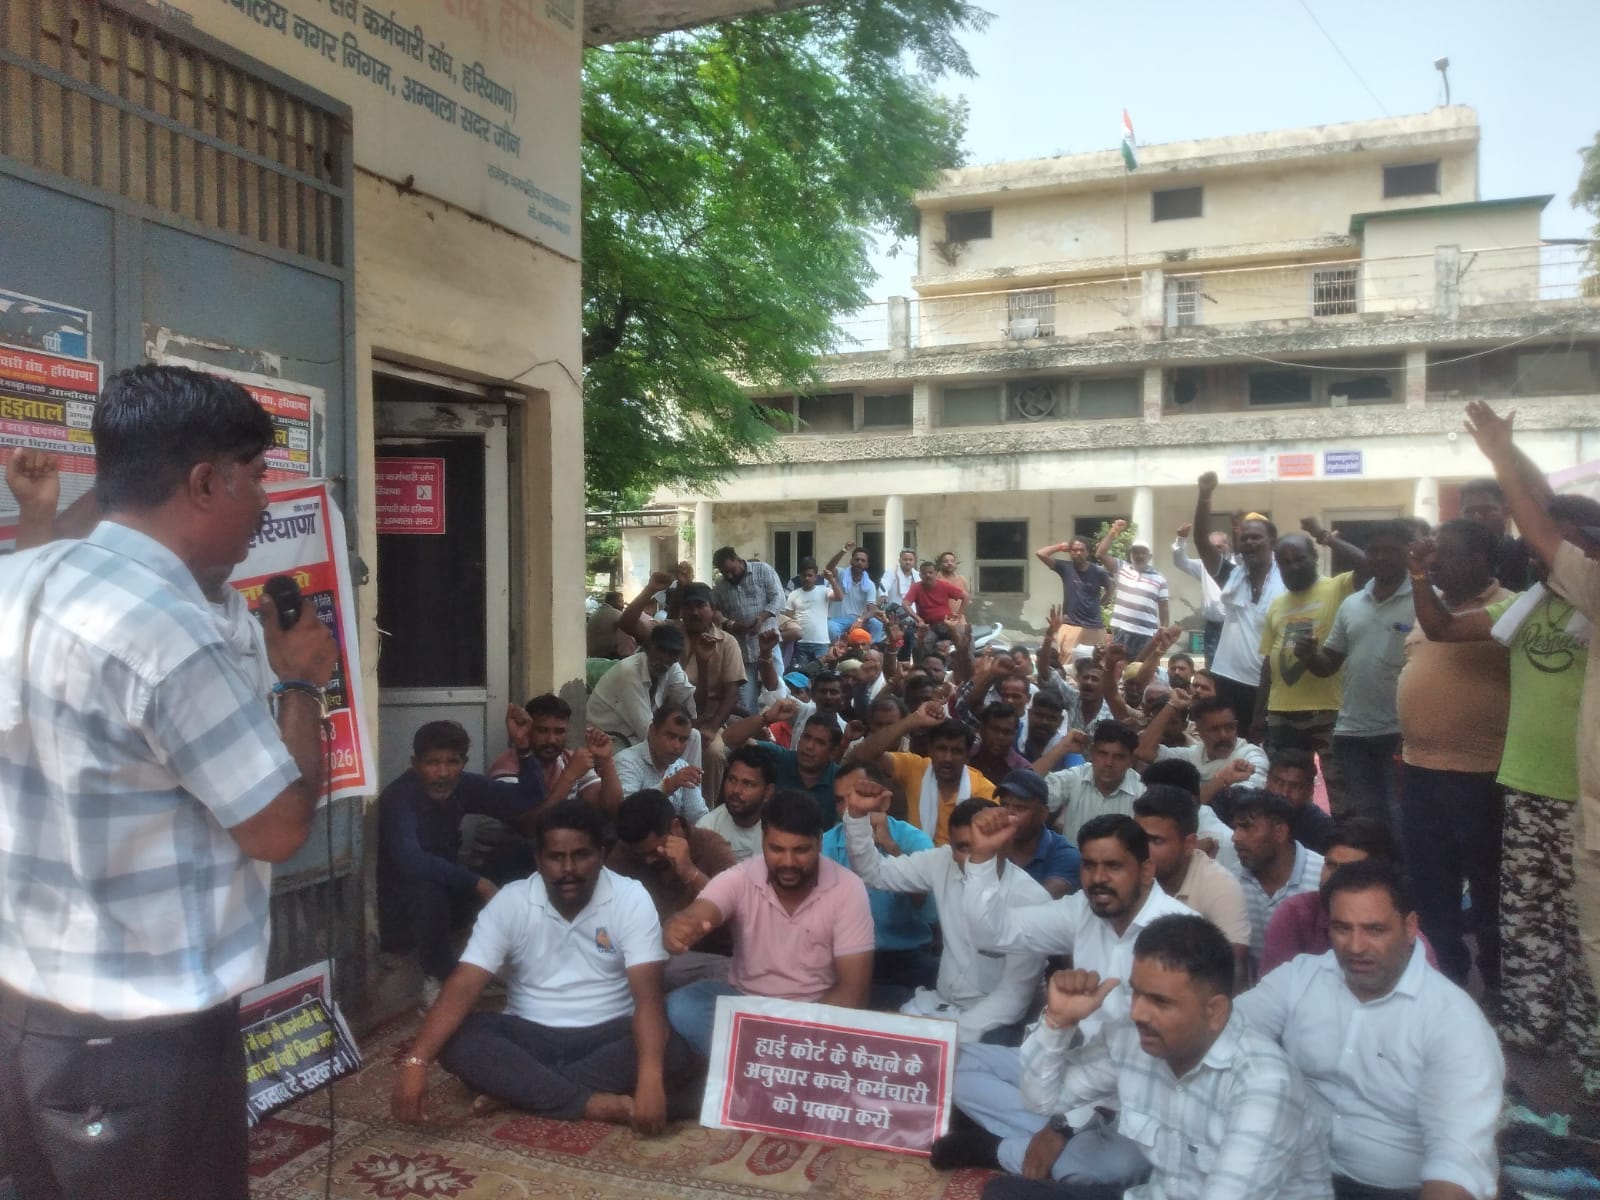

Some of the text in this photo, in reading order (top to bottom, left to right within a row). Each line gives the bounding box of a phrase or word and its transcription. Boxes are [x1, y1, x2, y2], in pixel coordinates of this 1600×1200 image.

[329, 0, 358, 24] सव
[362, 4, 425, 63] कर्मचारी
[427, 41, 457, 84] संघ,
[292, 13, 339, 62] नगर
[341, 31, 396, 96] निगम,
[401, 75, 458, 125] अम्बाला
[460, 105, 492, 142] सदर
[492, 119, 521, 159] जोन
[50, 364, 94, 382] हरियाणा
[0, 395, 64, 422] हड़ताल
[376, 485, 401, 496] रियाणा
[280, 1009, 315, 1036] कर्मचारी
[292, 1039, 320, 1060] किया
[755, 1035, 925, 1076] हाई कोर्ट के फैसले के
[250, 1082, 294, 1111] जवाब
[743, 1061, 931, 1105] अनुसार कच्चे कर्मचारी
[772, 1093, 893, 1130] को पक्का करो
